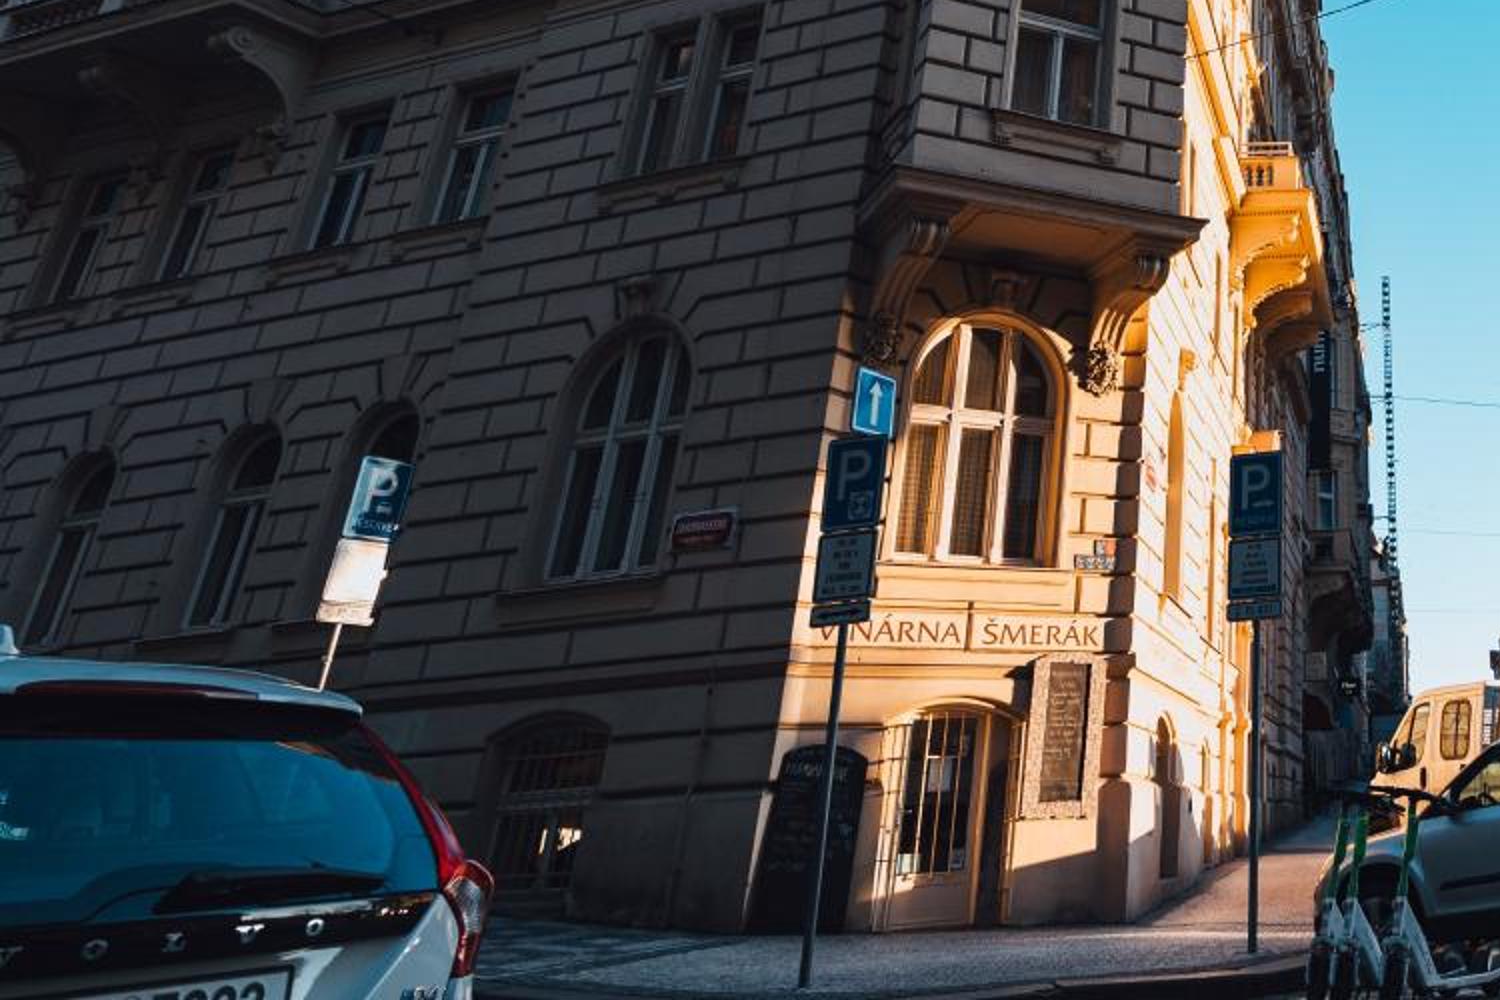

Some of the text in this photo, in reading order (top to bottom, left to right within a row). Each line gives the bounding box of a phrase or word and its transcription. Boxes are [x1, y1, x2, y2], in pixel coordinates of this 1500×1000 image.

[364, 469, 399, 514] P
[837, 450, 872, 501] P
[1241, 464, 1270, 510] P
[819, 613, 1098, 647] VNÁRNA ŠMERÁK
